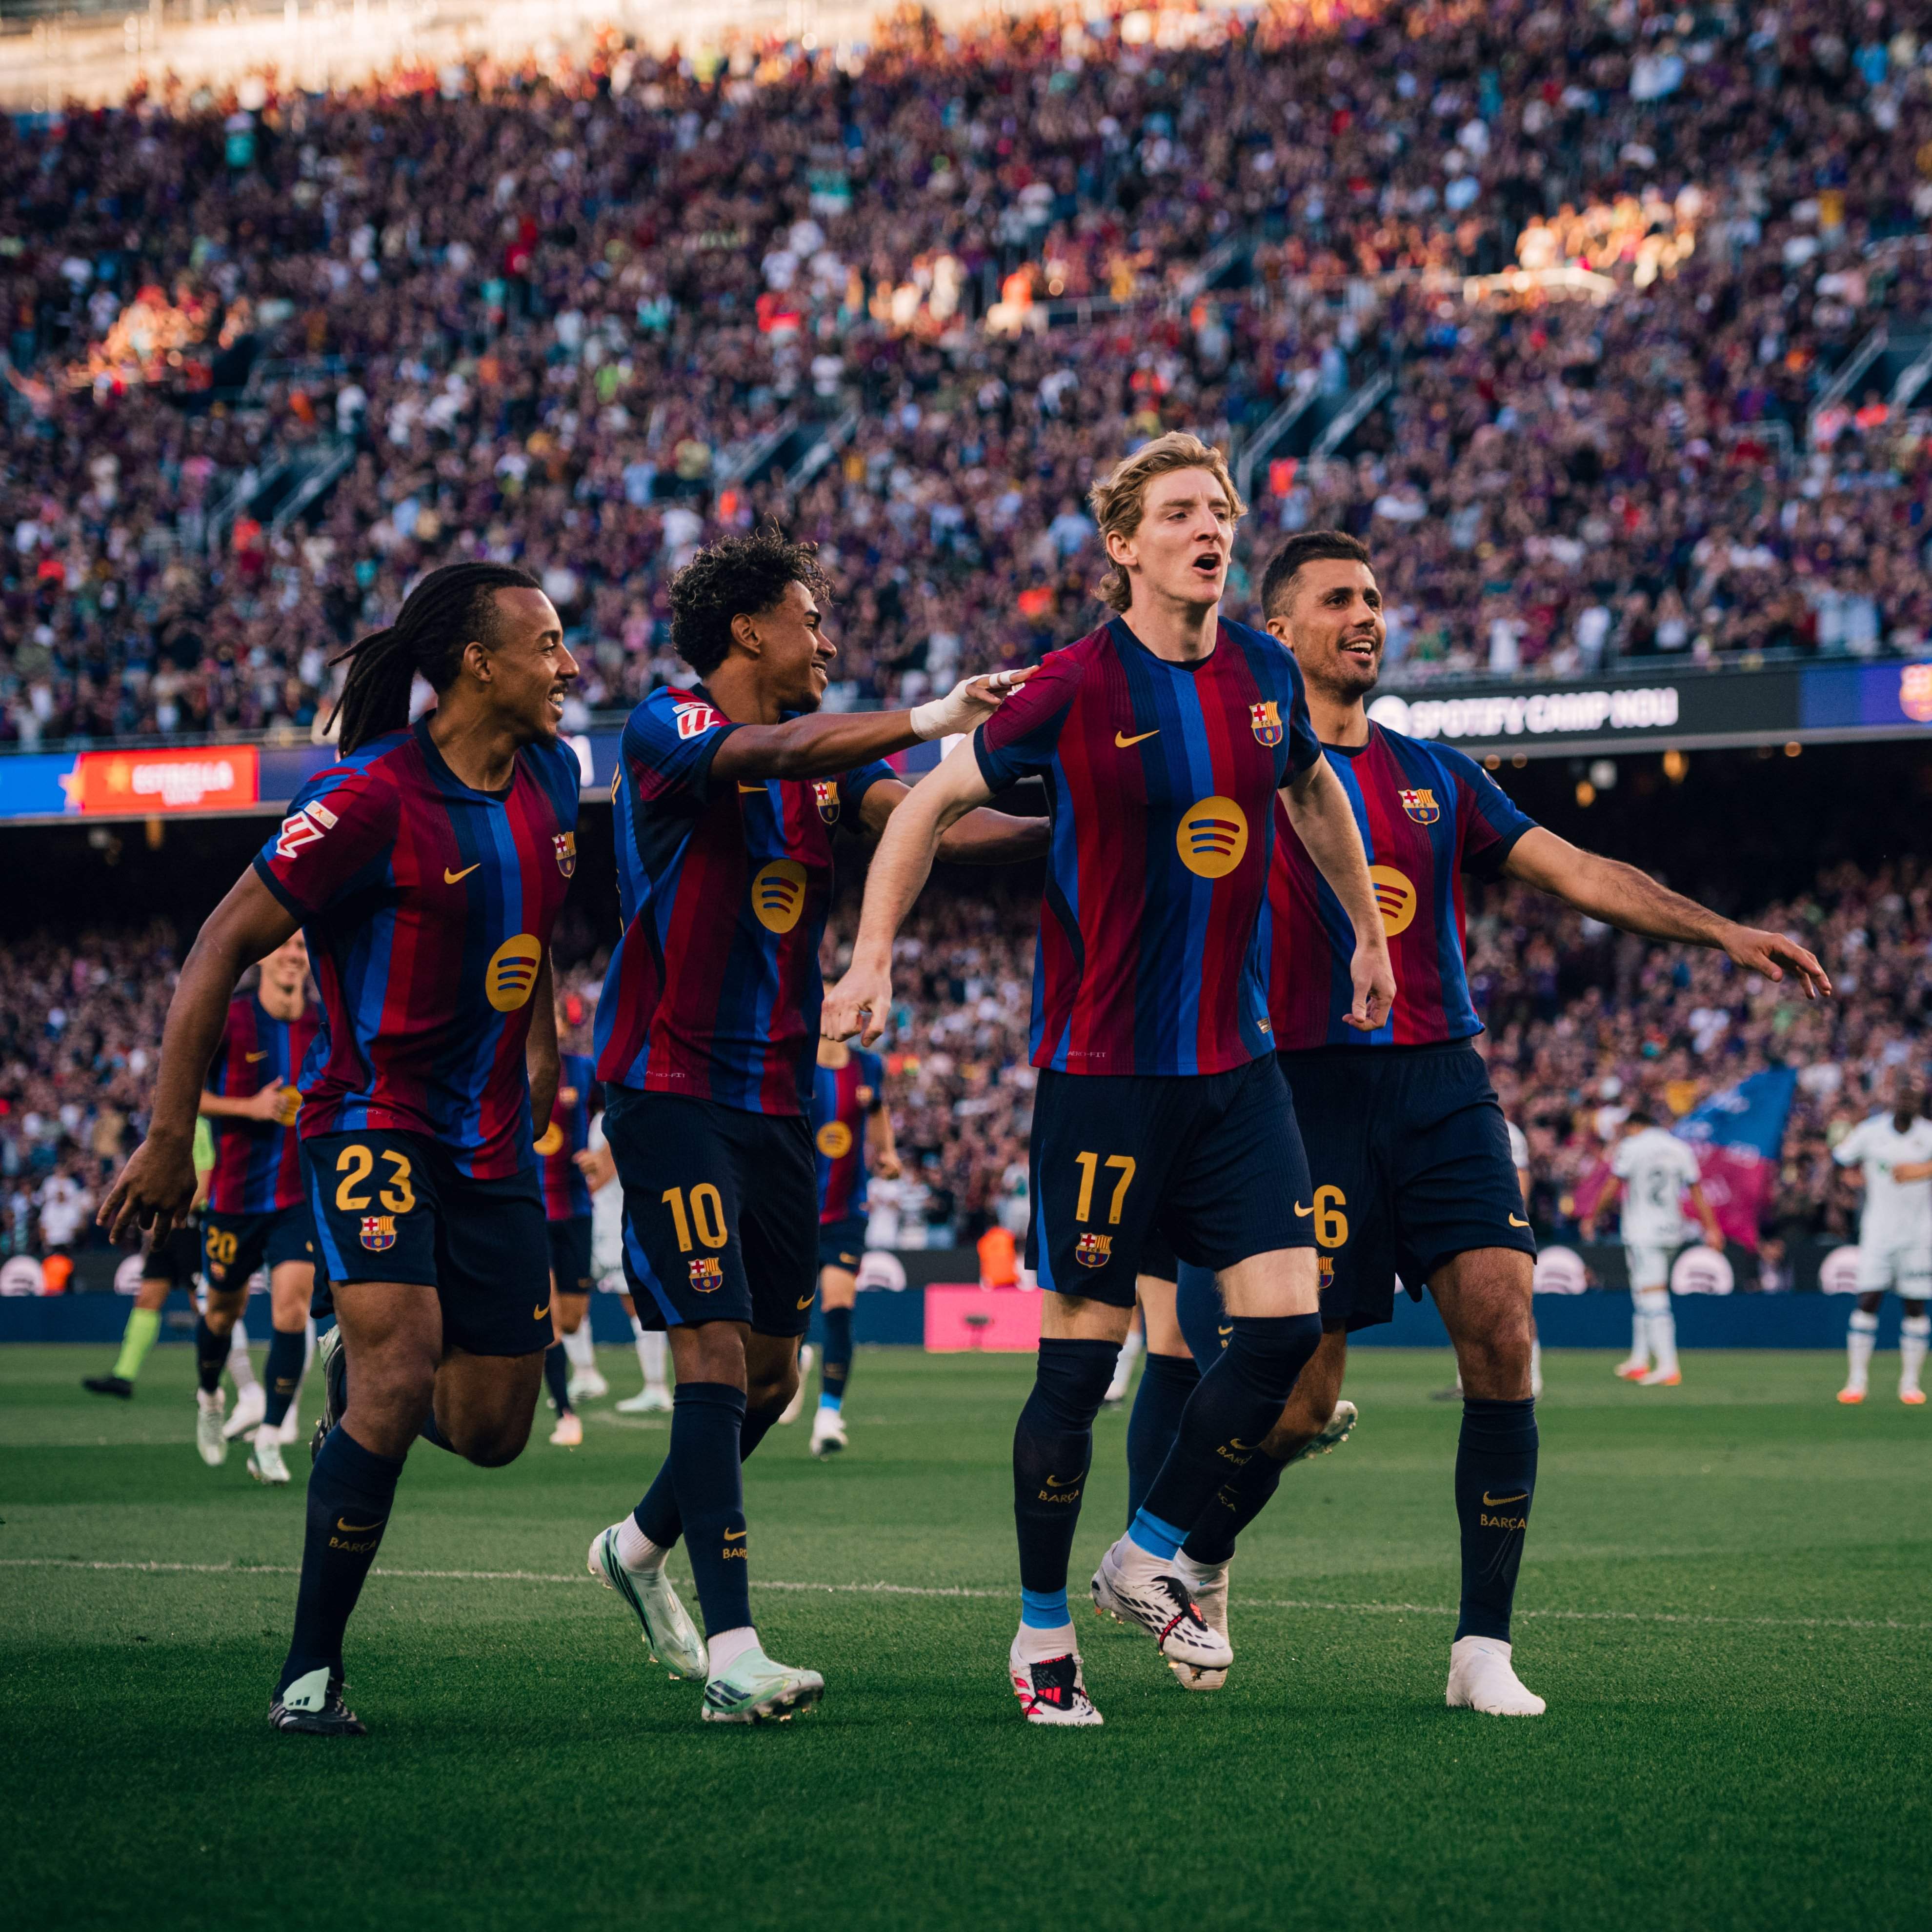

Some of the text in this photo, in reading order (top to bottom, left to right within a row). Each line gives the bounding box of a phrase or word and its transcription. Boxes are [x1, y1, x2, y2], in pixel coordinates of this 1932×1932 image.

[1409, 687, 1679, 739] SPOTIFY CAMP NOU
[335, 1144, 416, 1213] 23
[1075, 1151, 1136, 1224] 17
[205, 1225, 238, 1265] 20
[661, 1183, 728, 1252] 10
[1313, 1184, 1348, 1248] 6
[328, 1536, 376, 1554] BARÇA
[1480, 1513, 1526, 1531] BARÇA
